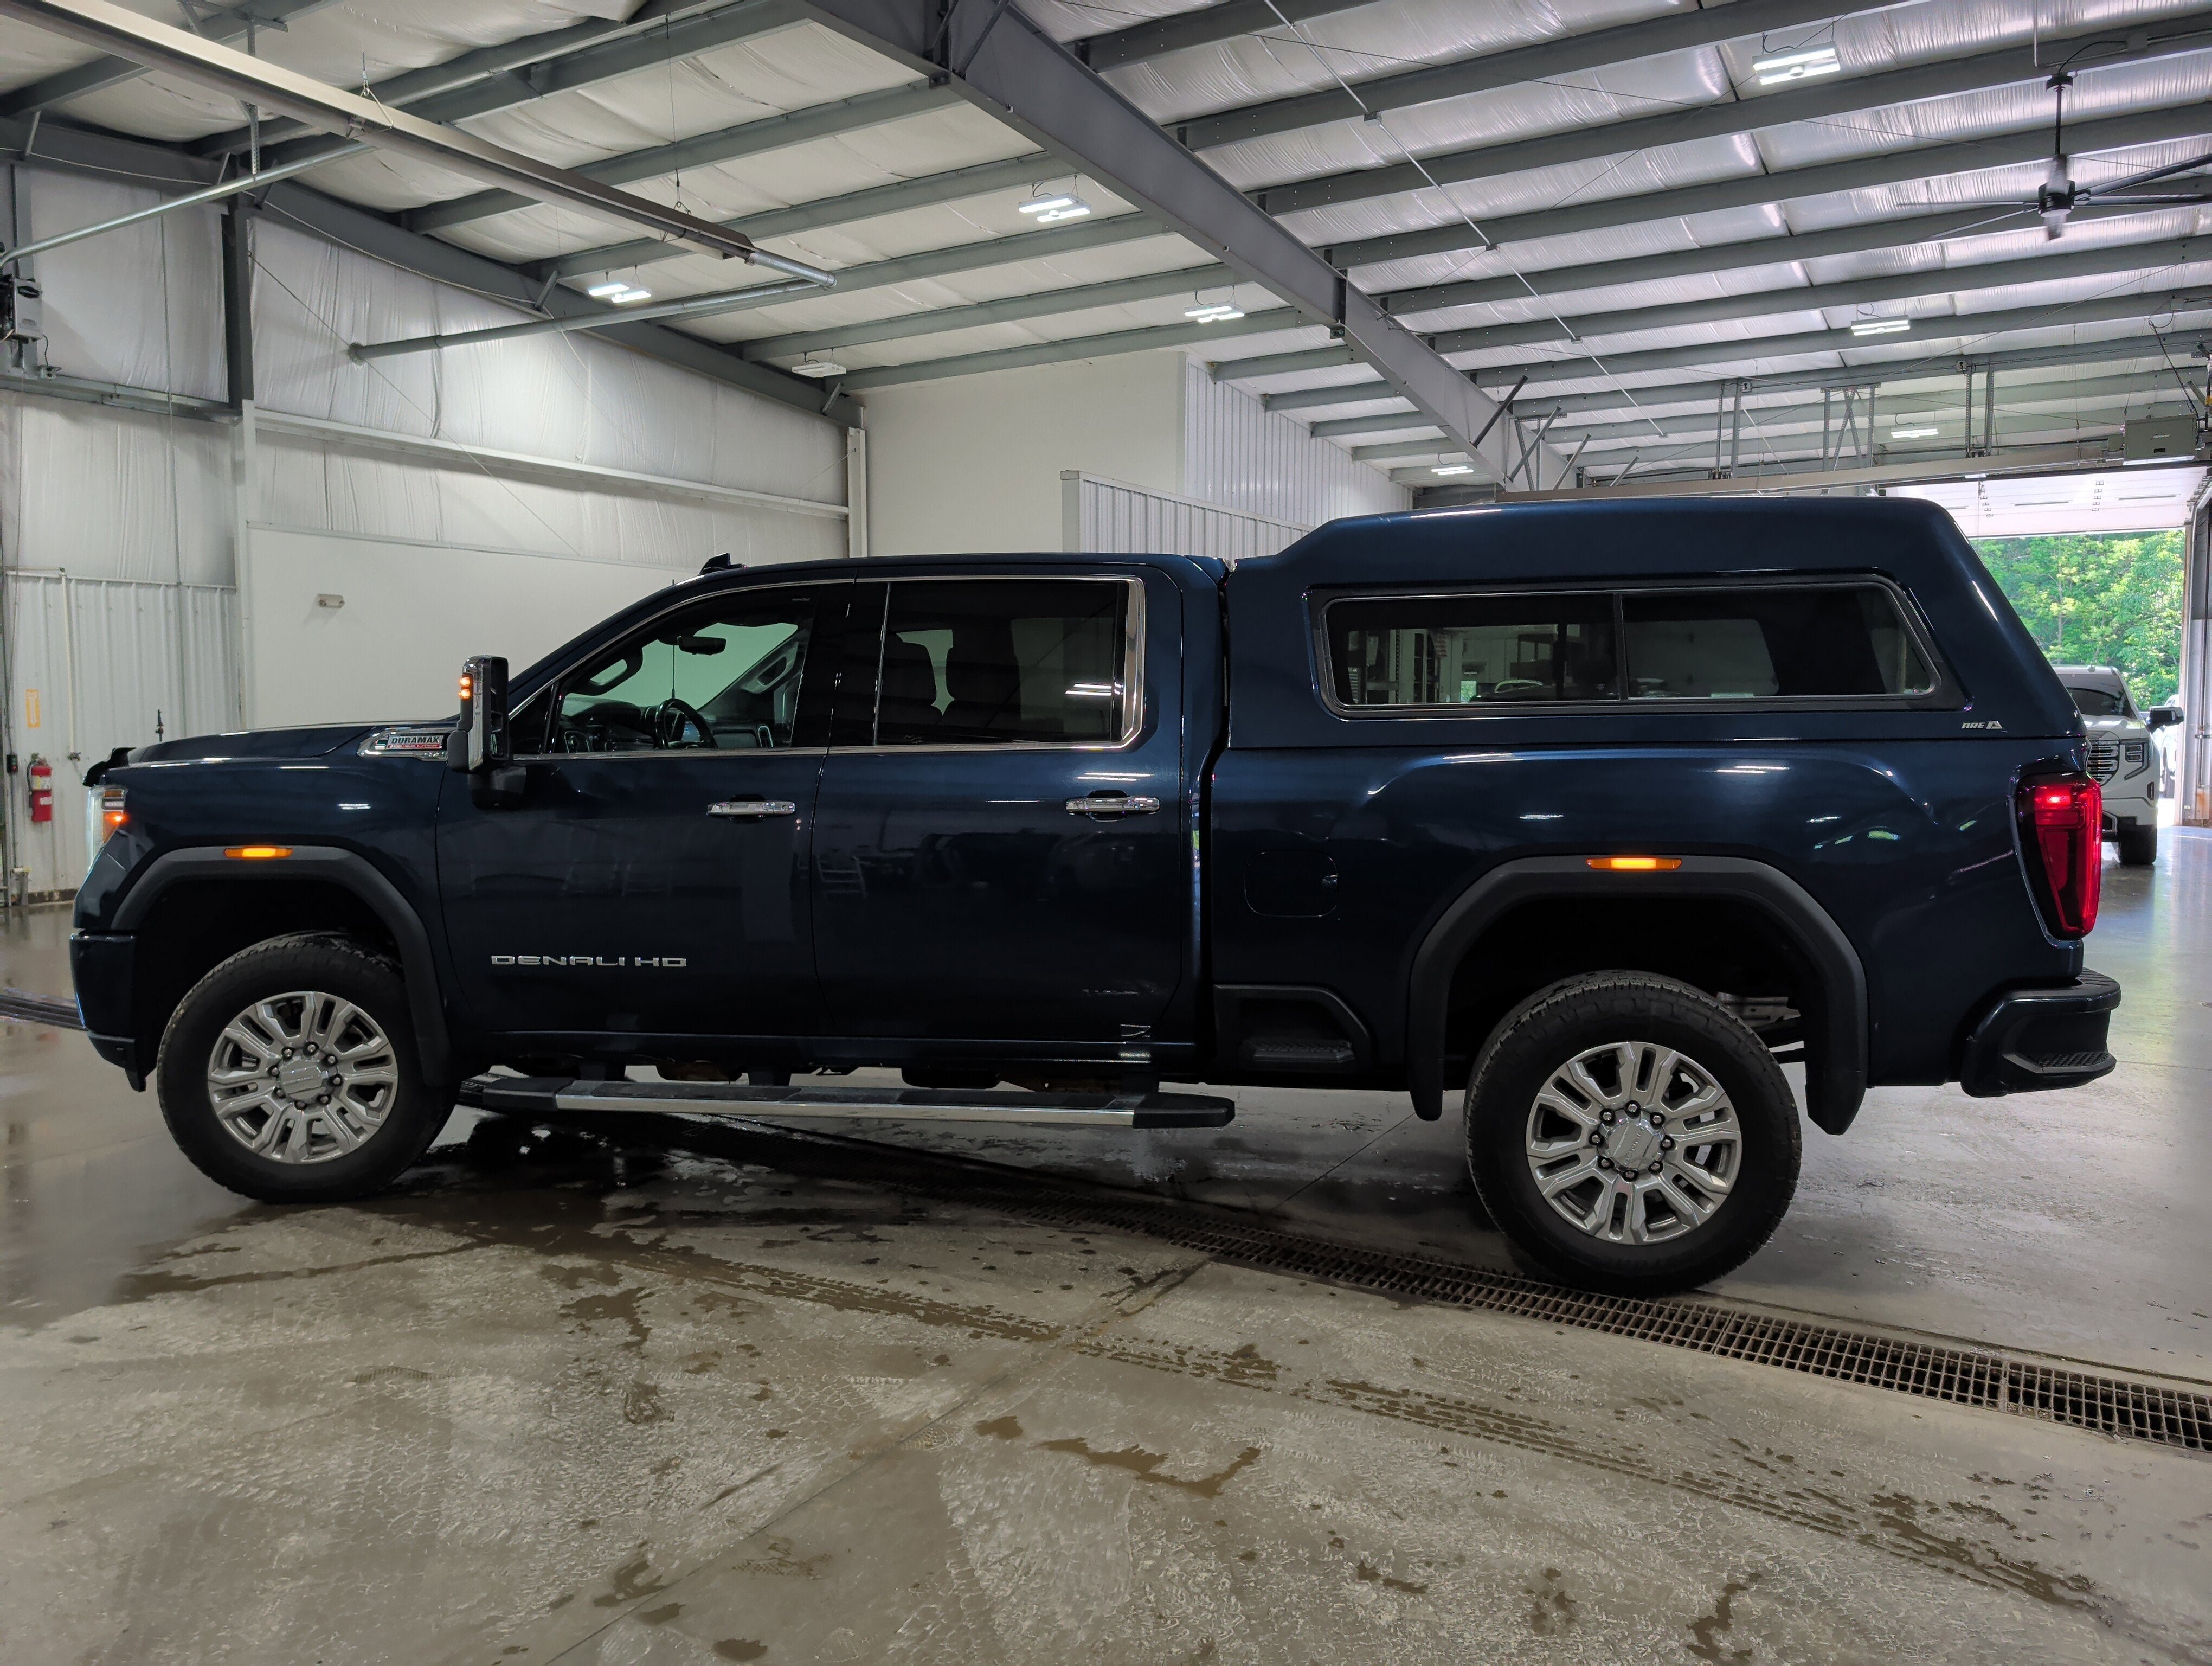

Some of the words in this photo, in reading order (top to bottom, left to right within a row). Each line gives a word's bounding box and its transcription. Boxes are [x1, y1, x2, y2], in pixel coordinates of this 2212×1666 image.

[391, 735, 440, 744] DURAMAX
[491, 955, 625, 966] DENALI
[634, 957, 687, 967] HD
